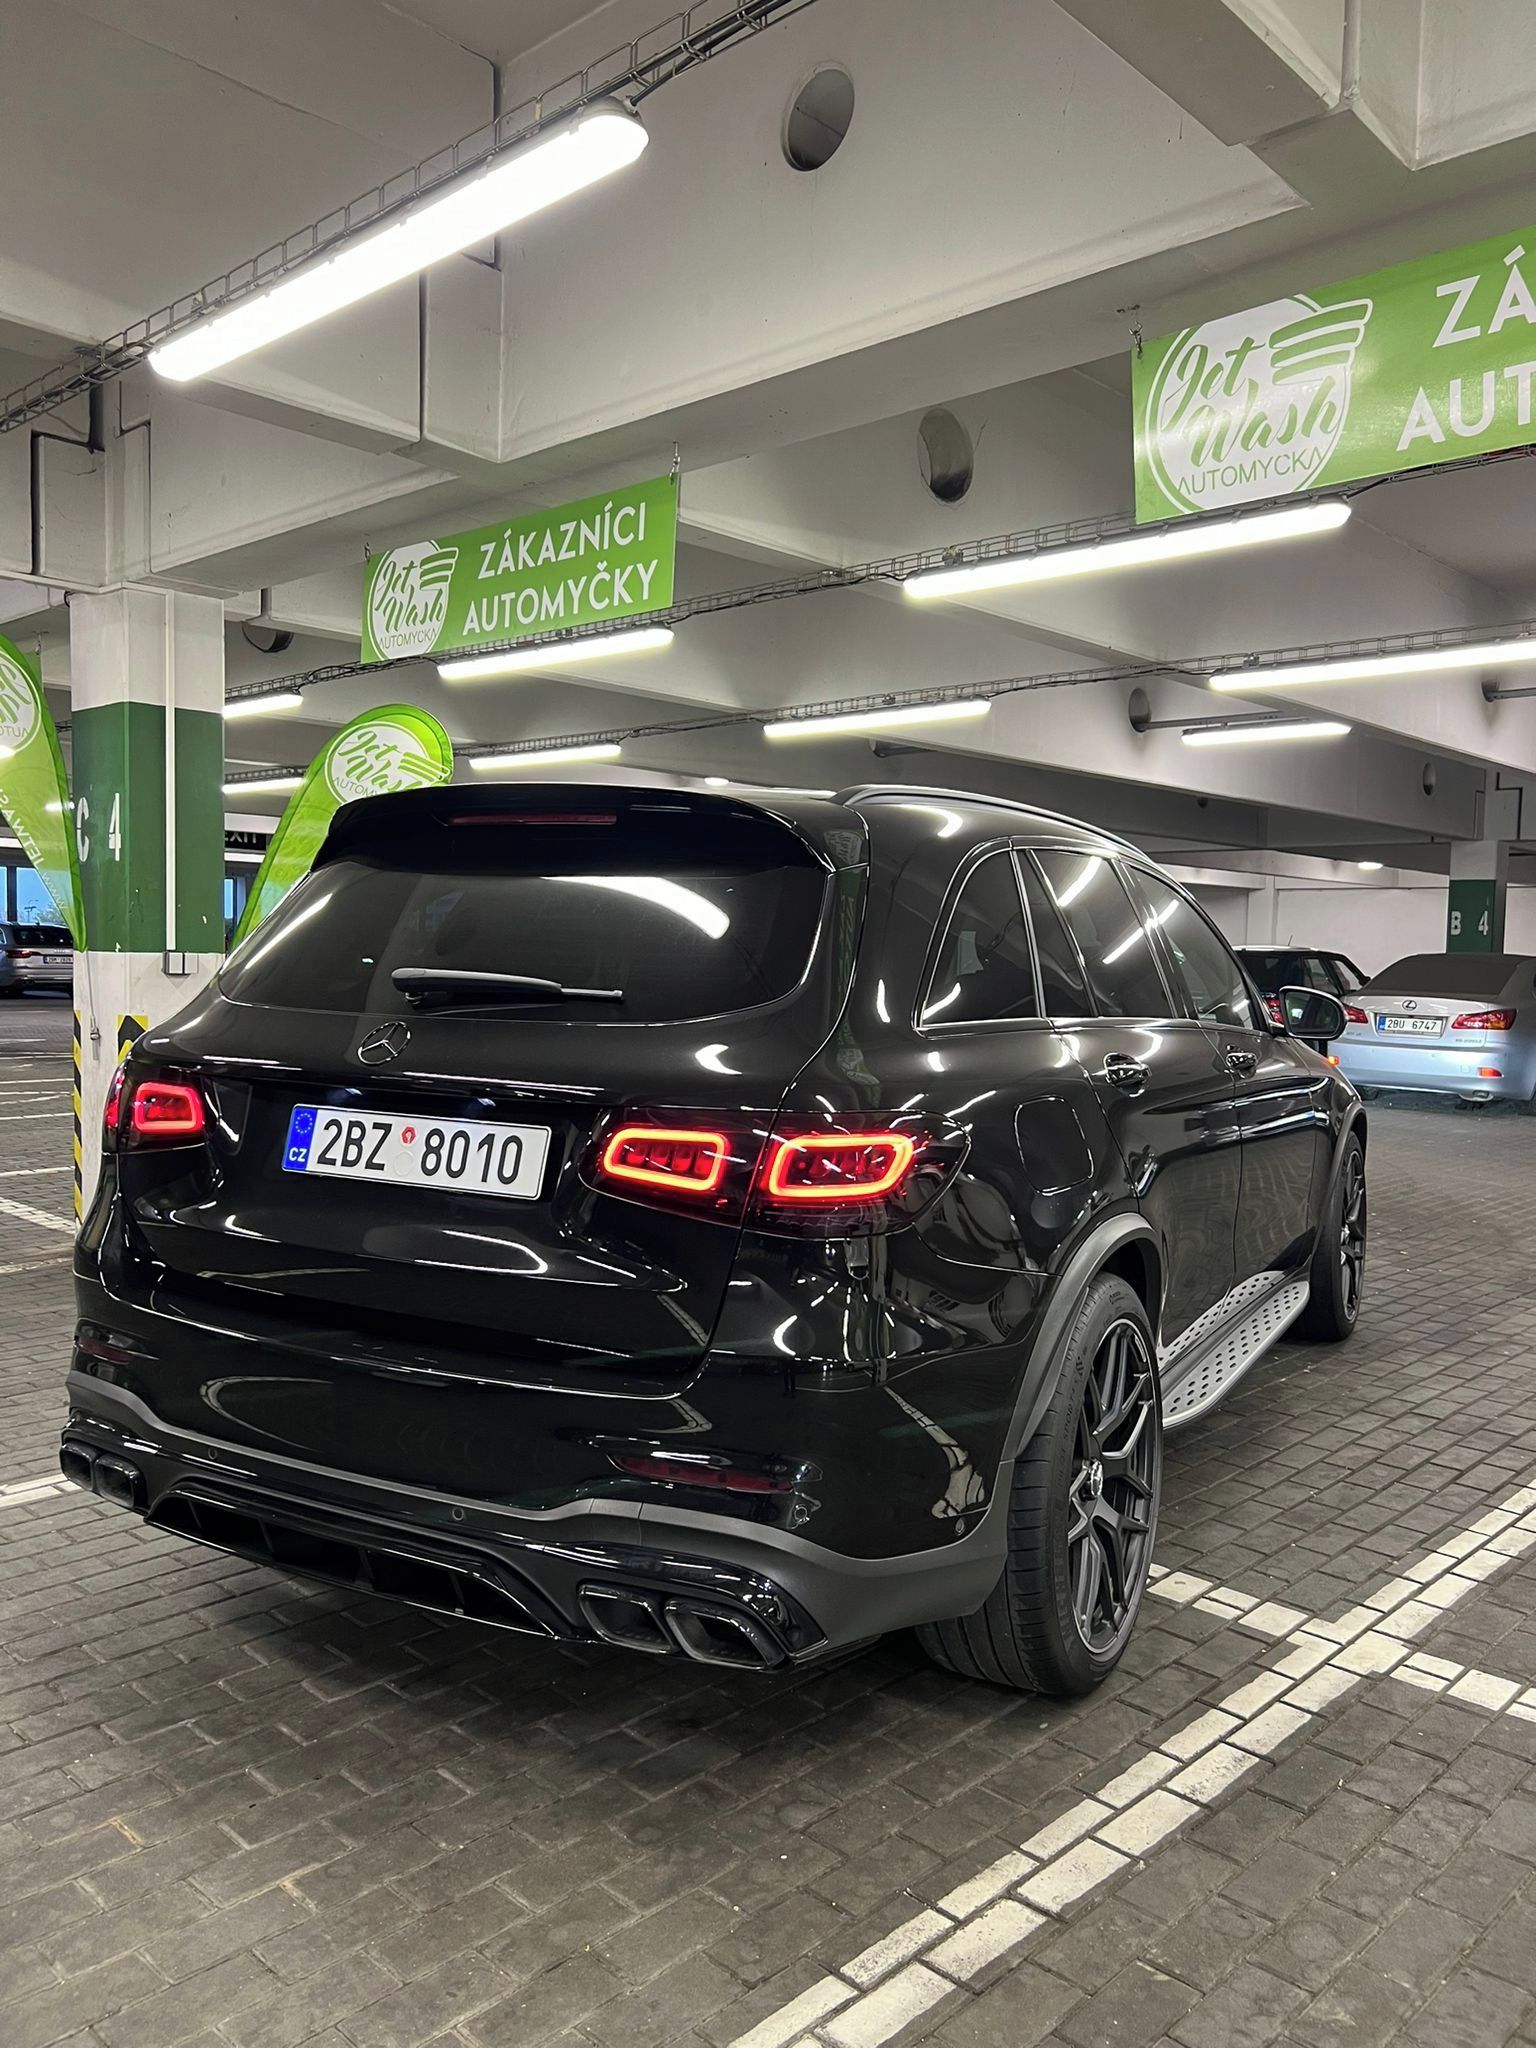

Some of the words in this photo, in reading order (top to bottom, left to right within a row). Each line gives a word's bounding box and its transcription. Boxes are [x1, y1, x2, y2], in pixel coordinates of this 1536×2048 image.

[1162, 337, 1266, 432] Jet
[1185, 376, 1338, 467] Wash
[478, 501, 647, 579] ZÁKAZNÍCI
[375, 560, 419, 611] Jet
[384, 587, 444, 633] Wash
[463, 559, 659, 637] AUTOMYČKY
[338, 730, 400, 760] Jet
[334, 777, 377, 798] AUTOM
[76, 796, 90, 863] C
[108, 792, 122, 862] 4
[1450, 910, 1462, 936] B
[1477, 910, 1489, 936] 4
[1387, 1019, 1406, 1029] 2BU
[1412, 1020, 1437, 1031] 6747
[288, 1147, 308, 1163] CZ
[317, 1118, 393, 1171] 2BZ
[420, 1128, 524, 1185] 8010
